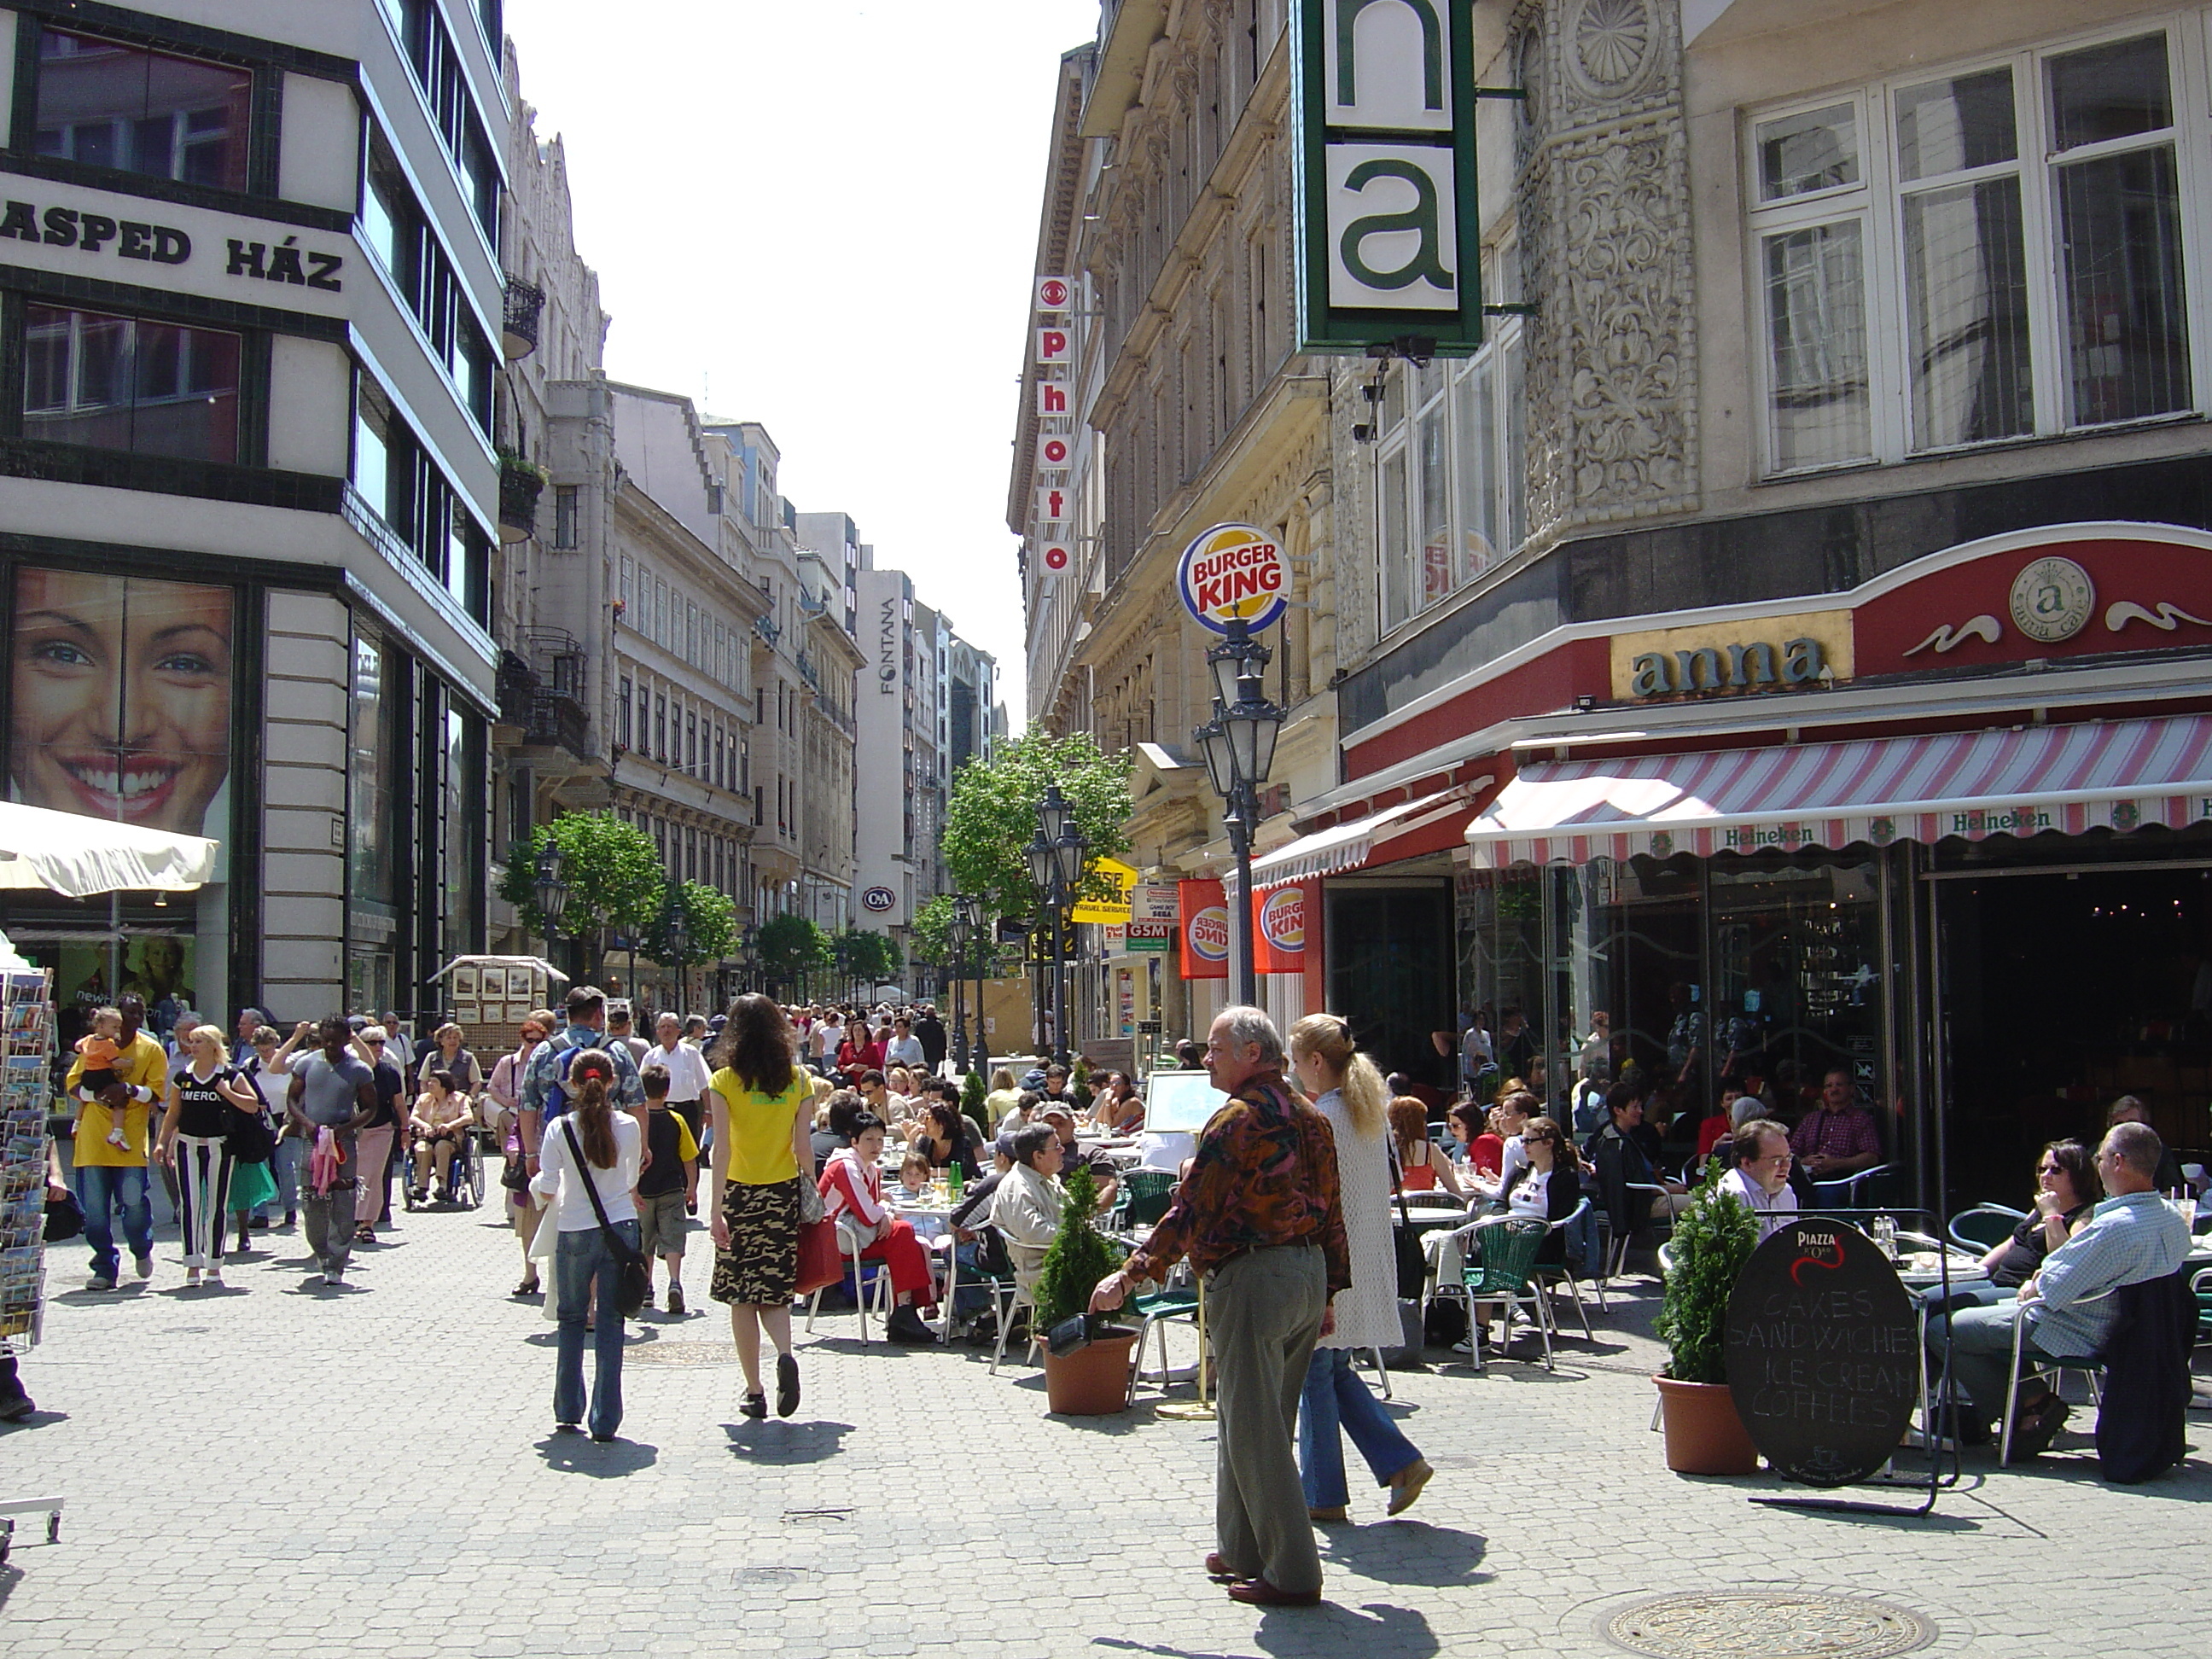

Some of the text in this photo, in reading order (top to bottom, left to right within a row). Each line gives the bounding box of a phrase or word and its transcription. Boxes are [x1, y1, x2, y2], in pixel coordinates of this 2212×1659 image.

[0, 201, 344, 293] ASPED HÁZ
[1042, 331, 1068, 570] photo
[1193, 544, 1278, 585] BURGER
[1198, 562, 1282, 614] KING
[879, 597, 896, 695] FONTANA
[1632, 637, 1820, 696] anna
[1726, 825, 1813, 847] Heineken
[1953, 811, 2051, 833] Heineken
[868, 893, 889, 905] C&A
[1130, 925, 1165, 937] GSM
[1271, 913, 1303, 939] KIN
[1797, 1231, 1836, 1247] PIAZZA
[1764, 1289, 1874, 1318] CAKES
[1729, 1320, 1919, 1356] SANDWICHES
[1766, 1356, 1914, 1398] ICE CREAM
